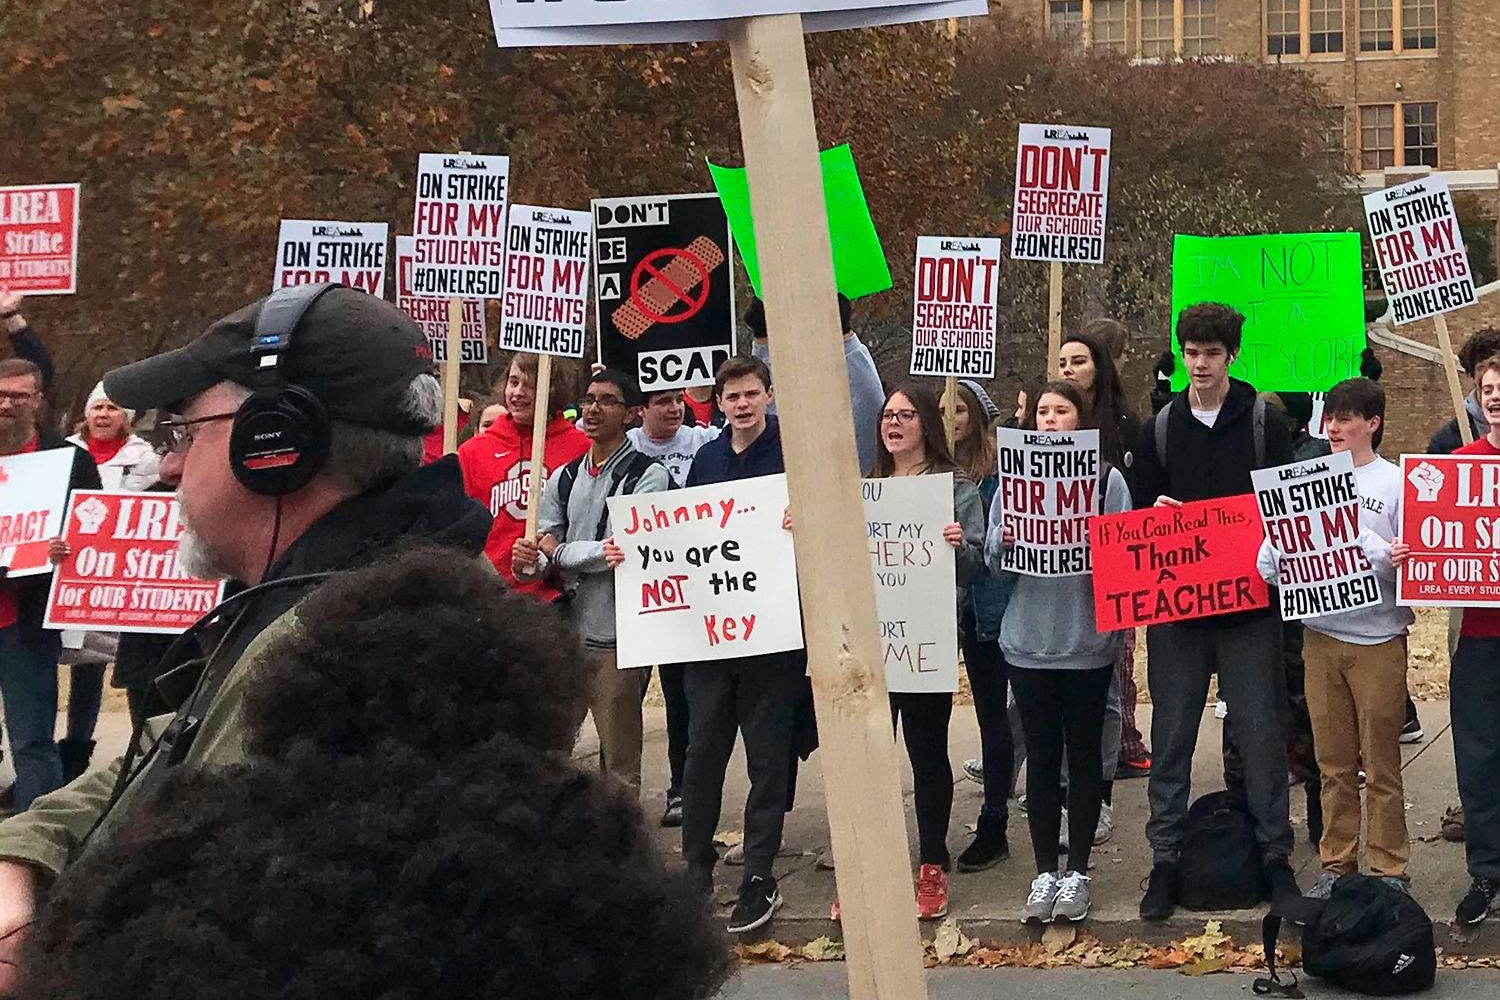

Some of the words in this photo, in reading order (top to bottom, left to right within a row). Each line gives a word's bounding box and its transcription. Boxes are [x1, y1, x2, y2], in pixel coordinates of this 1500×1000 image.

[1019, 145, 1107, 191] DON'T
[420, 173, 442, 198] ON
[448, 175, 505, 201] STRIKE
[417, 202, 458, 235] FOR
[468, 203, 502, 237] MY
[598, 202, 668, 224] DON'T
[1017, 215, 1041, 232] OUR
[1046, 217, 1101, 235] SCHOOLS
[317, 242, 384, 268] STRIKE
[535, 227, 587, 258] STRIKE
[600, 240, 625, 261] BE
[1015, 234, 1101, 261] #ONELRSD
[1376, 232, 1418, 269] FOR
[1424, 218, 1457, 253] MY
[507, 255, 547, 291] FOR
[552, 259, 585, 295] MY
[1261, 239, 1344, 289] NOT
[1385, 253, 1466, 296] STUDENTS
[415, 269, 500, 295] #ONELRSD
[601, 276, 619, 296] A
[918, 256, 996, 303] DON'T
[505, 292, 583, 324] STUDENTS
[1288, 303, 1306, 325] A
[1394, 280, 1474, 322] #ONELRSD
[917, 304, 992, 330] SEGREGATE
[916, 329, 937, 347] OUR
[941, 330, 992, 349] SCHOOLS
[914, 350, 992, 374] #ONELRSD
[254, 432, 282, 440] SONY
[1002, 477, 1045, 514] FOR
[1057, 479, 1096, 515] MY
[1289, 472, 1357, 508] STRIKE
[898, 524, 923, 538] MY
[1116, 522, 1139, 543] You
[1142, 516, 1171, 538] Can
[1173, 511, 1208, 533] Read
[1212, 507, 1252, 526] This,
[1421, 516, 1463, 549] On
[638, 545, 674, 570] you
[686, 539, 740, 567] are
[1127, 534, 1210, 571] Thank
[1279, 546, 1371, 585] STUDENTS
[877, 573, 906, 587] YOU
[1156, 568, 1177, 584] A
[1407, 558, 1436, 582] for
[1443, 559, 1482, 582] OUR
[90, 586, 124, 608] OUR
[642, 575, 688, 609] NOT
[710, 571, 757, 595] the
[1107, 576, 1256, 623] TEACHER
[1284, 575, 1378, 617] #ONELRSD
[1420, 586, 1441, 594] LREA
[1450, 586, 1475, 594] EVERY
[885, 643, 938, 673] ME
